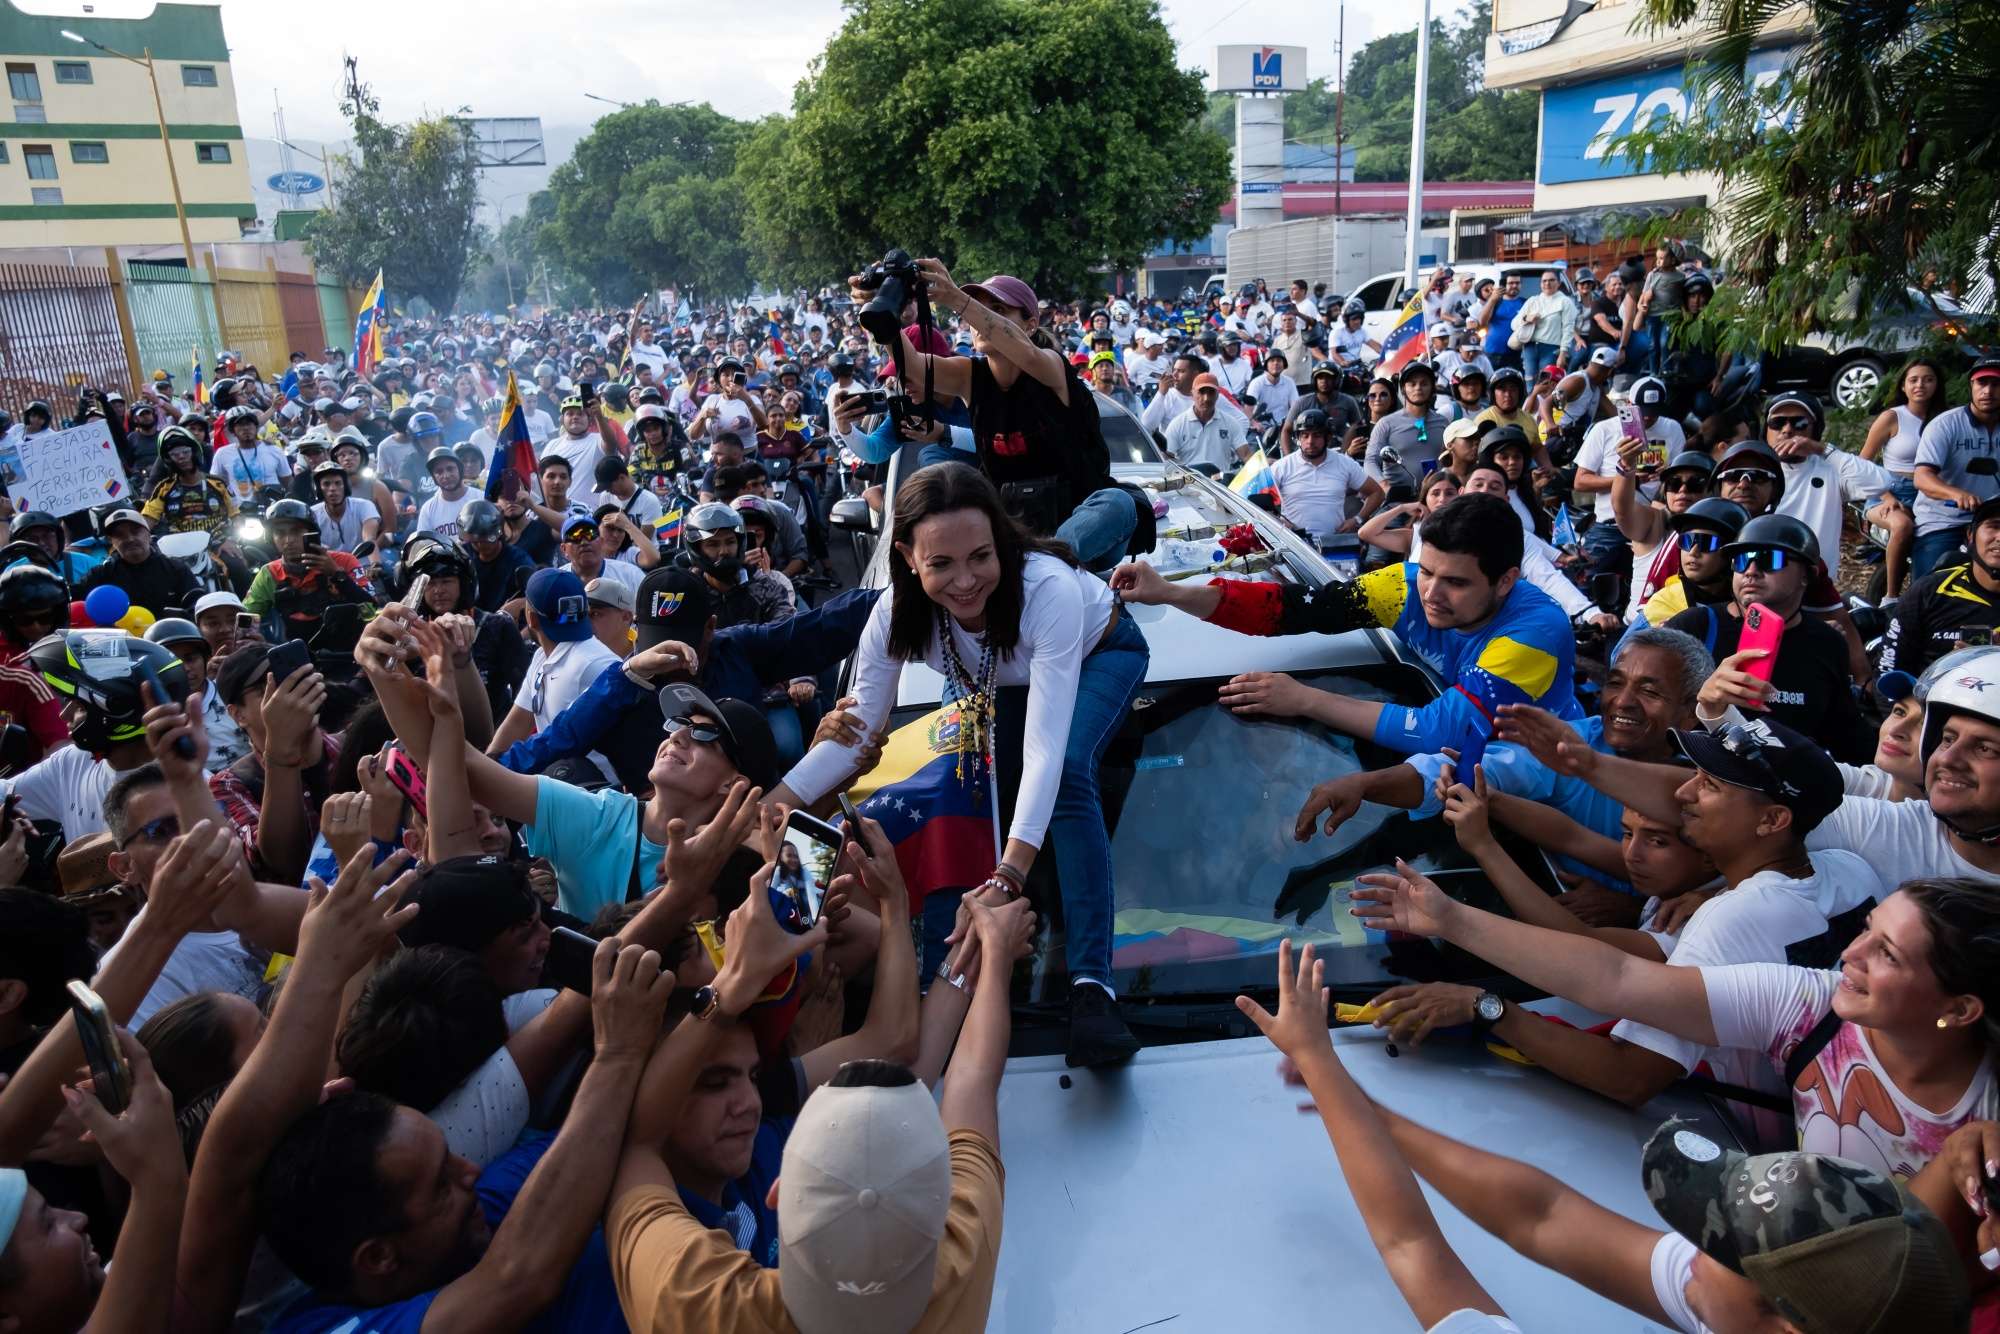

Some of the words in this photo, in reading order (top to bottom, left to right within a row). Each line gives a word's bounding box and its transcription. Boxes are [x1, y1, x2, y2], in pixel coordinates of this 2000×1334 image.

[1255, 75, 1280, 86] PDV
[42, 428, 102, 456] ESTADO
[1956, 437, 2000, 450] HILFI
[38, 487, 102, 512] OPOSITOR
